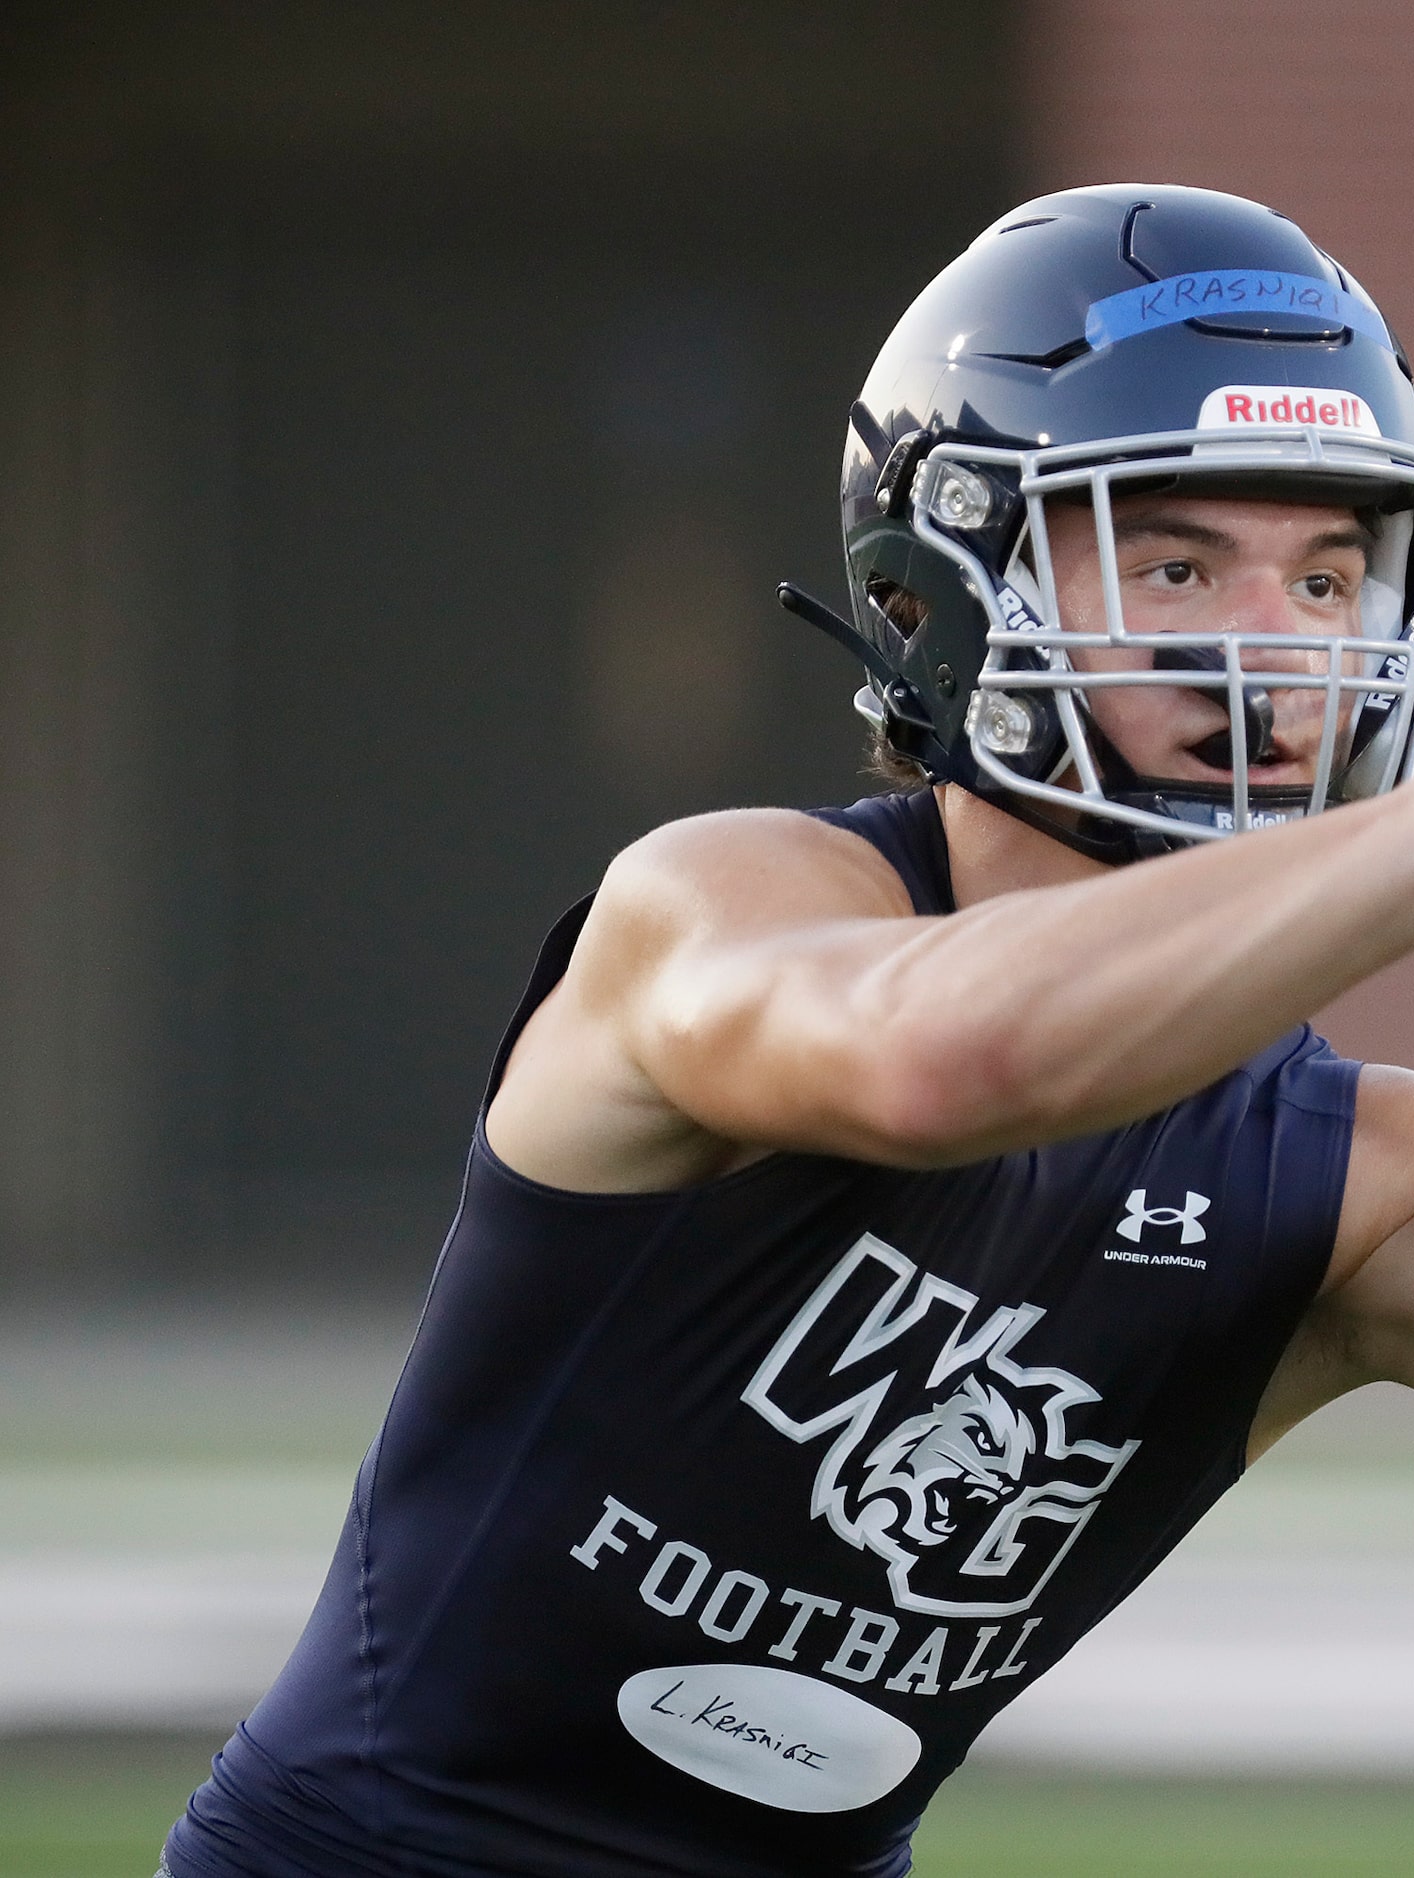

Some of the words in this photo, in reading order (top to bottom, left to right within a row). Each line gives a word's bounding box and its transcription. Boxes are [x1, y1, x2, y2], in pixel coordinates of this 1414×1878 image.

[1140, 277, 1340, 321] KRASNIQI
[1224, 393, 1362, 428] Riddell
[1103, 1250, 1150, 1265] UNDER
[1150, 1255, 1208, 1271] ARMOUR
[569, 1494, 1043, 1697] FOOTBALL
[650, 1680, 687, 1718] L.
